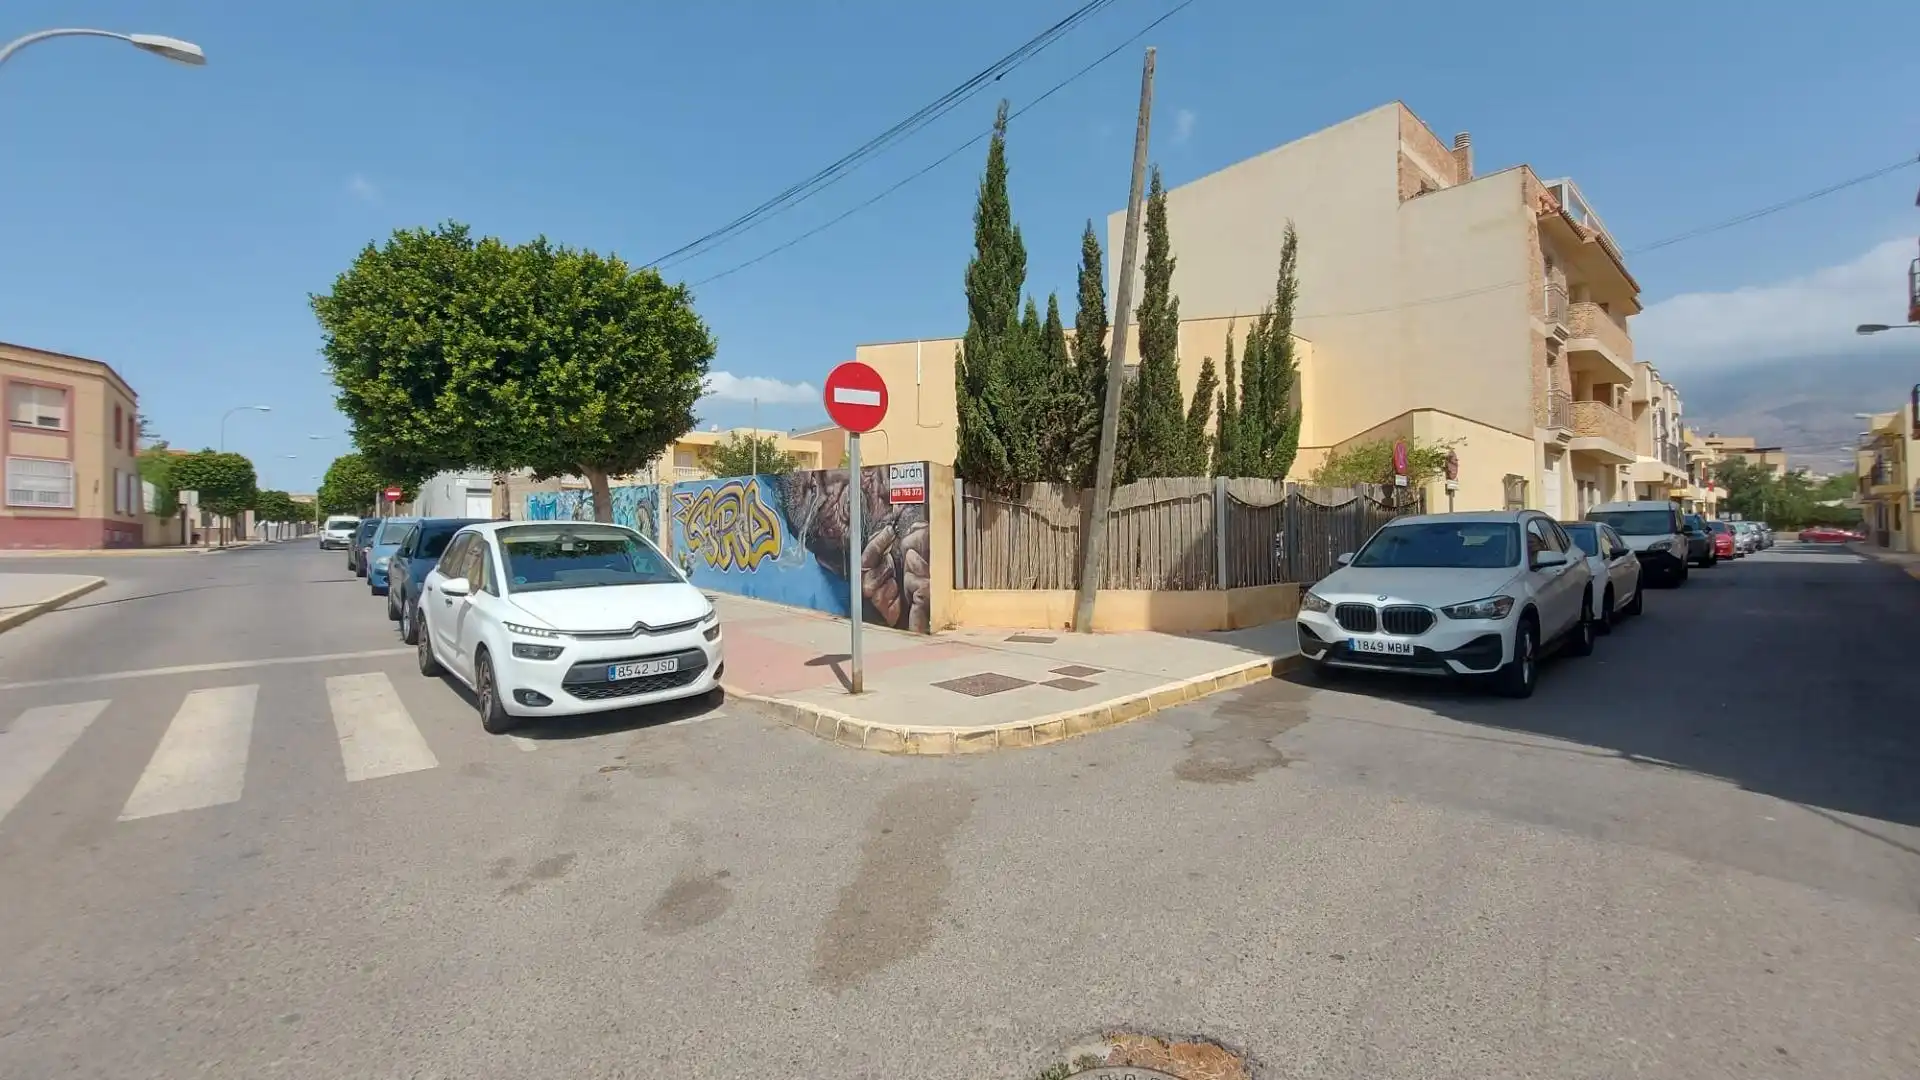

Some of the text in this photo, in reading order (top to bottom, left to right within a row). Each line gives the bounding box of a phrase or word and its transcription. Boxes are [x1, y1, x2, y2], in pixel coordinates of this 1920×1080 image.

[891, 464, 922, 480] Durán
[1357, 640, 1410, 653] 1849 MBM
[618, 660, 675, 678] 8542 JSD
